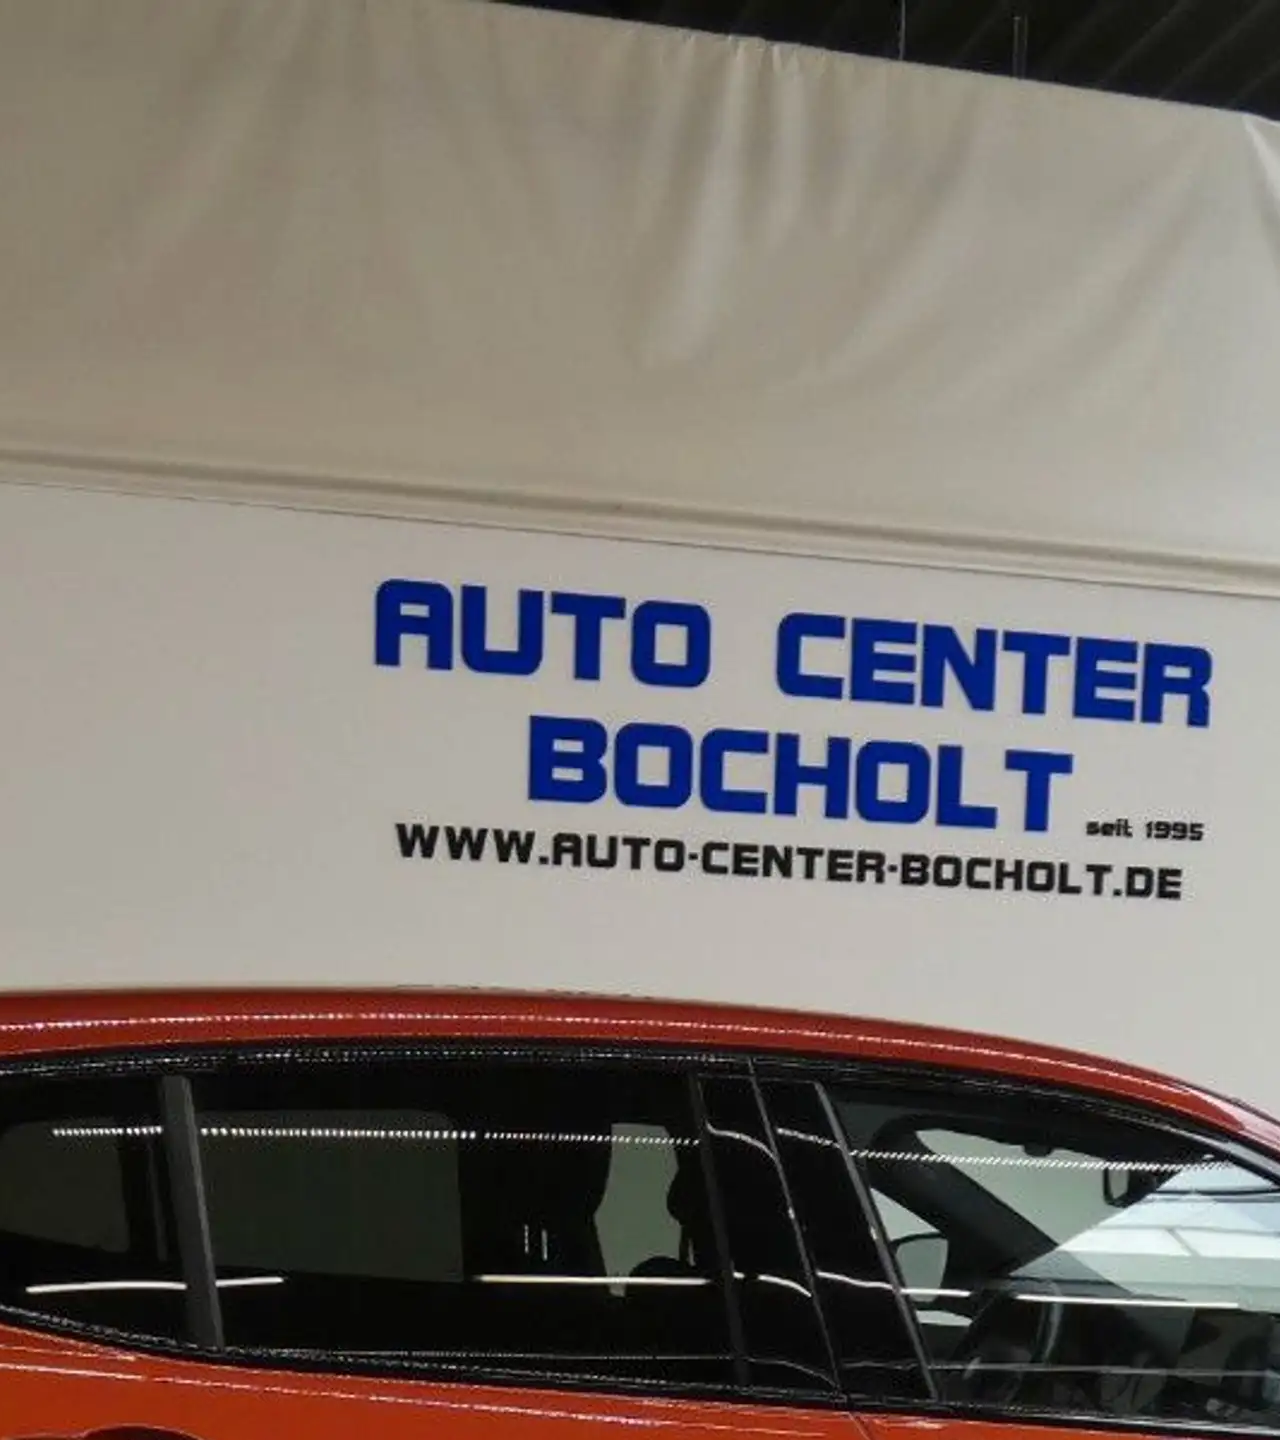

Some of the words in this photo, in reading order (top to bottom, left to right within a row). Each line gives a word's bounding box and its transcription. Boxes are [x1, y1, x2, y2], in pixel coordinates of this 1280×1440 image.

[375, 579, 712, 688] AUTO
[776, 612, 1215, 728] CENTER
[528, 714, 1074, 833] BOCHOLT
[395, 822, 1183, 900] WWW.AUTO-CENTER-BOCHOLT.DE
[1086, 818, 1133, 838] seit
[1145, 820, 1204, 841] 1995
